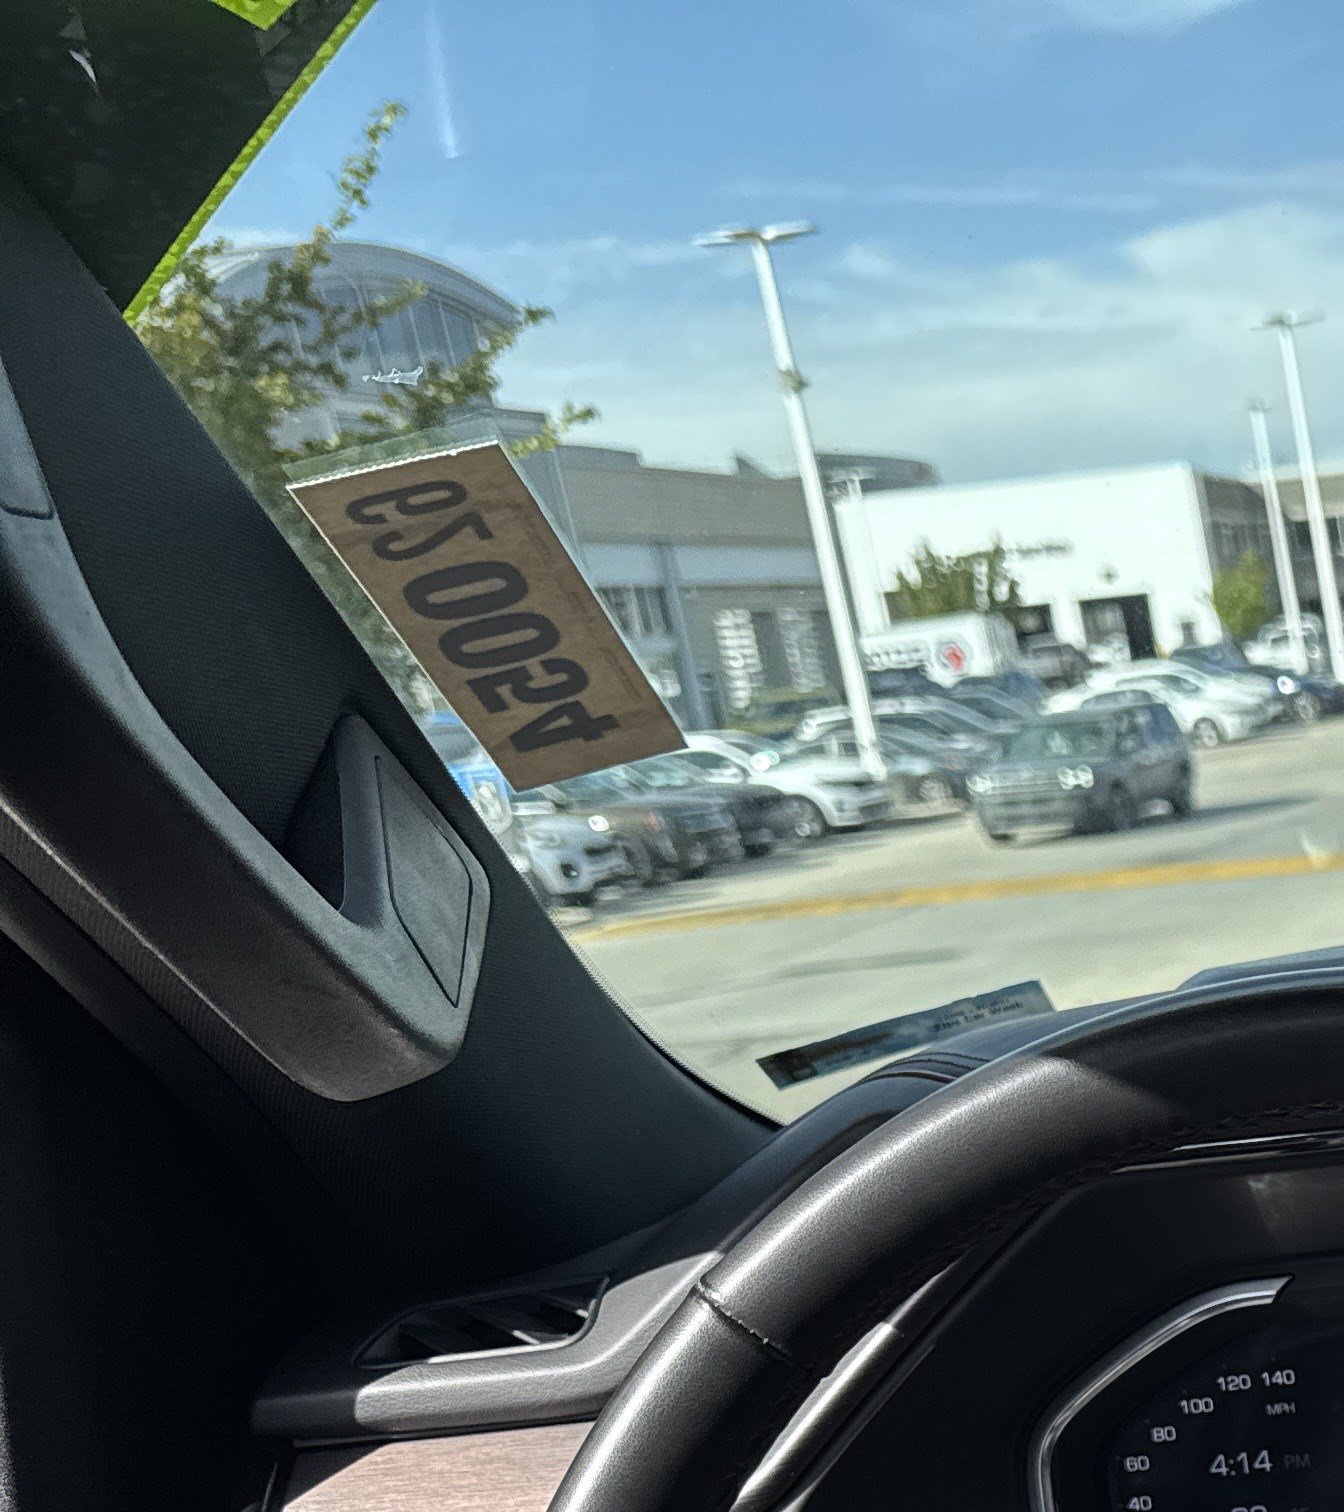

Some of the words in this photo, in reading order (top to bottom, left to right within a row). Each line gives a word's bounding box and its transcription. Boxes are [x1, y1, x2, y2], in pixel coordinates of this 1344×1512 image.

[1217, 1374, 1252, 1392] 120
[1260, 1369, 1296, 1387] 140
[1180, 1397, 1214, 1415] 100
[1265, 1402, 1296, 1417] MPH
[1151, 1425, 1177, 1443] 80
[1125, 1455, 1150, 1473] 60
[1209, 1449, 1272, 1477] 4:14
[1126, 1495, 1152, 1512] 40
